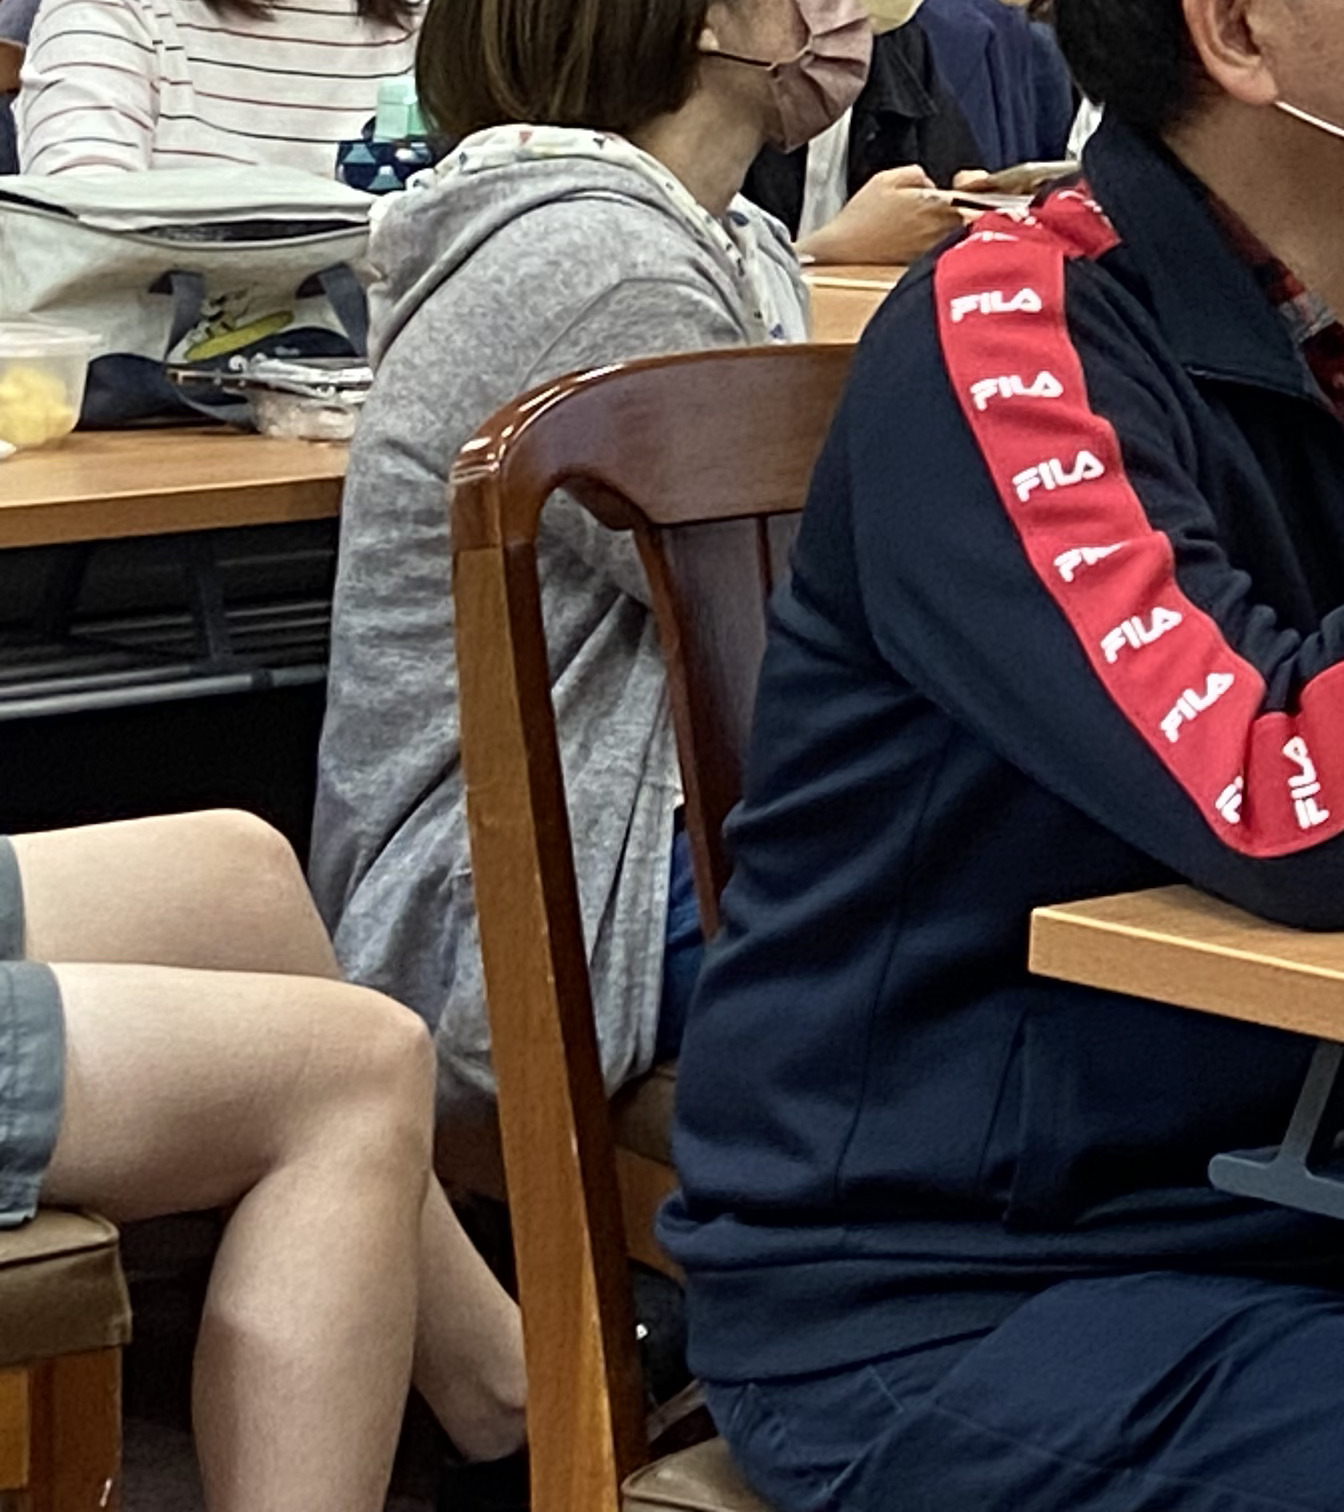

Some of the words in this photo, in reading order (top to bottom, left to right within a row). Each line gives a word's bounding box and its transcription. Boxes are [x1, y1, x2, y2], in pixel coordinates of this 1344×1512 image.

[950, 288, 1042, 323] FILA
[970, 370, 1064, 411] FILA
[1012, 449, 1105, 502] FILA
[1100, 606, 1183, 665] FILA
[1160, 672, 1235, 744] FILA
[1281, 735, 1330, 831] FILA
